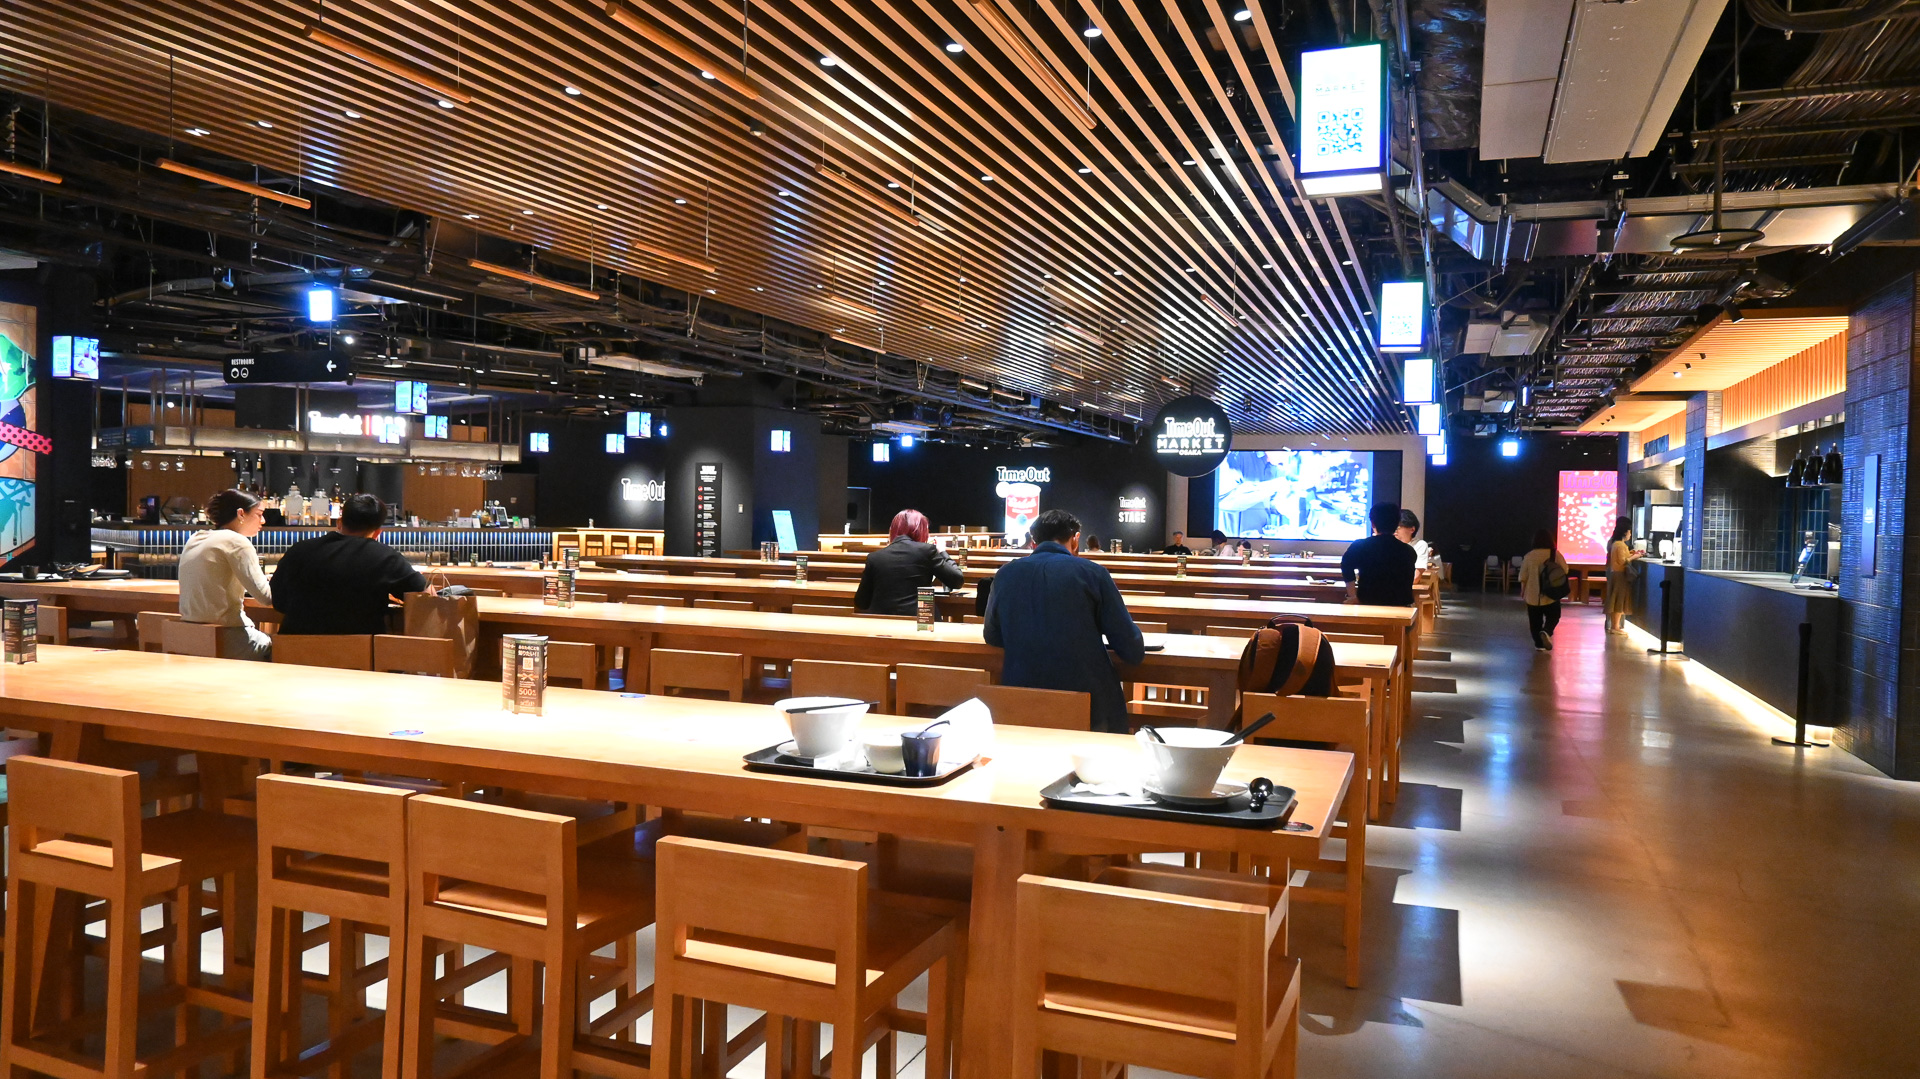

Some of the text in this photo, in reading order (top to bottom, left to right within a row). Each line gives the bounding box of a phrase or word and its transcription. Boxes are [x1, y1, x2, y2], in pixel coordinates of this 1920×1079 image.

[1164, 417, 1215, 438] Time Out
[1157, 438, 1225, 449] MARKET
[996, 466, 1050, 482] Time Out
[1561, 471, 1601, 489] Time
[621, 478, 648, 500] Time
[1119, 496, 1146, 508] Time Out
[1118, 511, 1146, 523] STAGE
